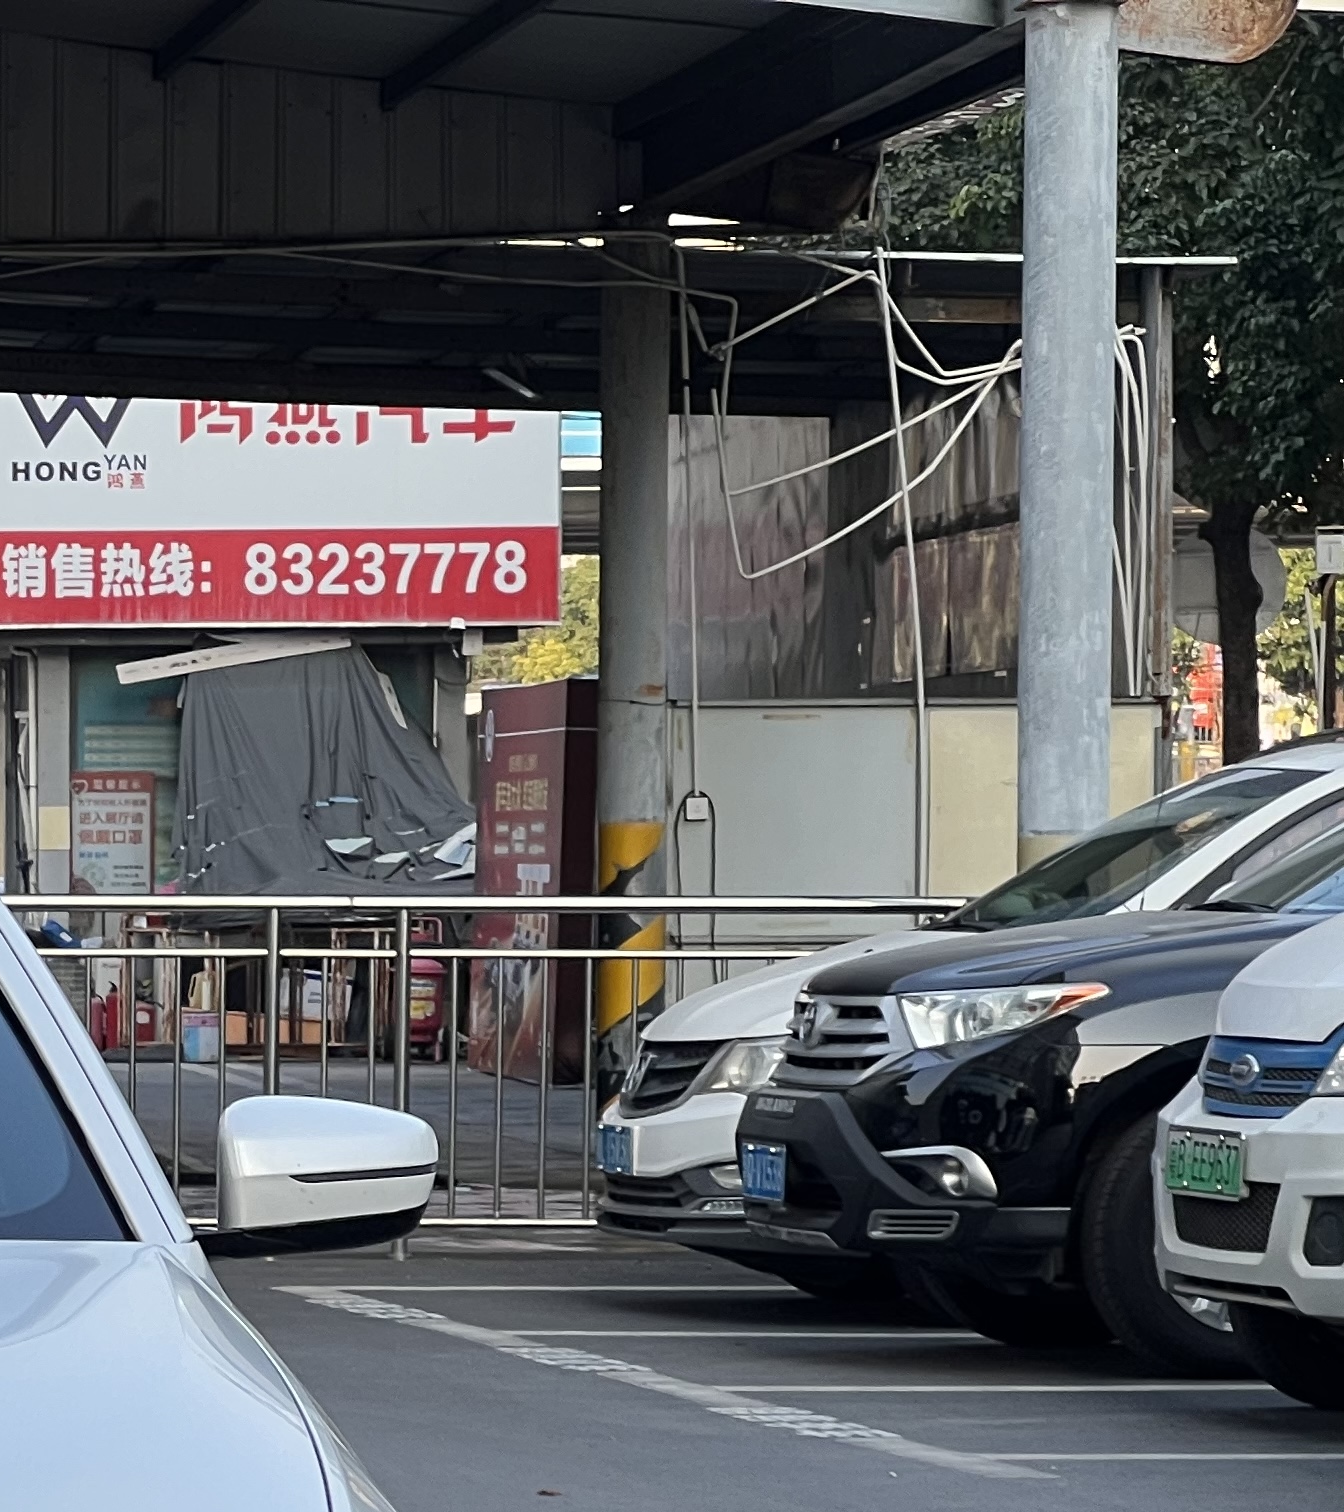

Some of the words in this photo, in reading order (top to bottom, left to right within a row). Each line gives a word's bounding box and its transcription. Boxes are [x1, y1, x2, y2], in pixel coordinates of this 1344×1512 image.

[11, 461, 102, 482] HONG
[103, 454, 147, 471] YAN
[1, 542, 212, 599] 销售热线：
[243, 541, 528, 597] 83237778
